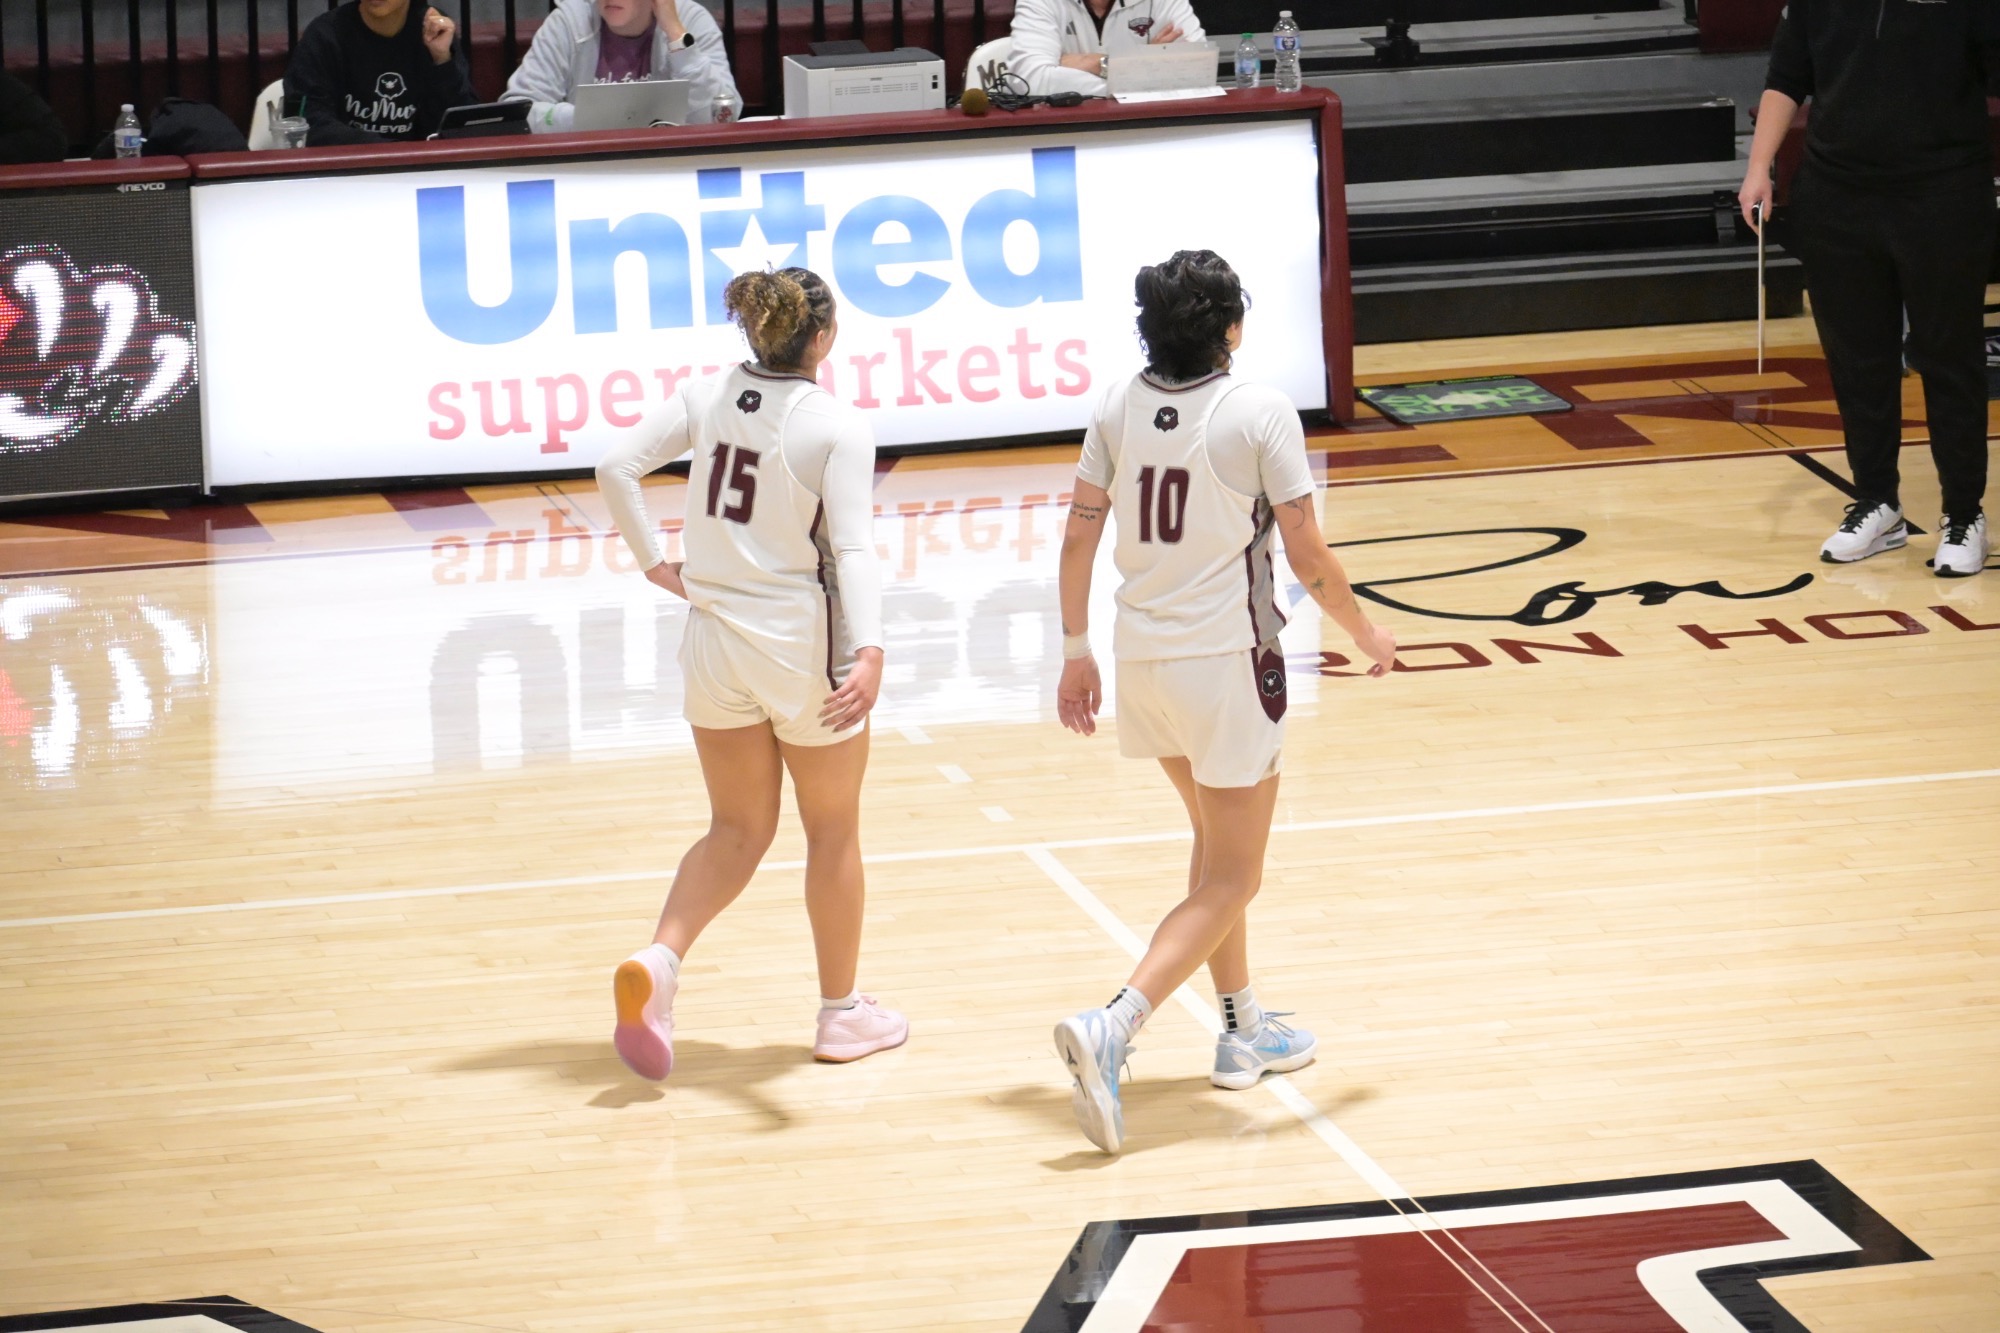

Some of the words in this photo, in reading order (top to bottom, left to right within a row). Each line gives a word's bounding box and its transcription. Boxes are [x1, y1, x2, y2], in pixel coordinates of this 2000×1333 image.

[416, 146, 1084, 345] United
[706, 440, 762, 526] 15
[1136, 465, 1190, 545] 10
